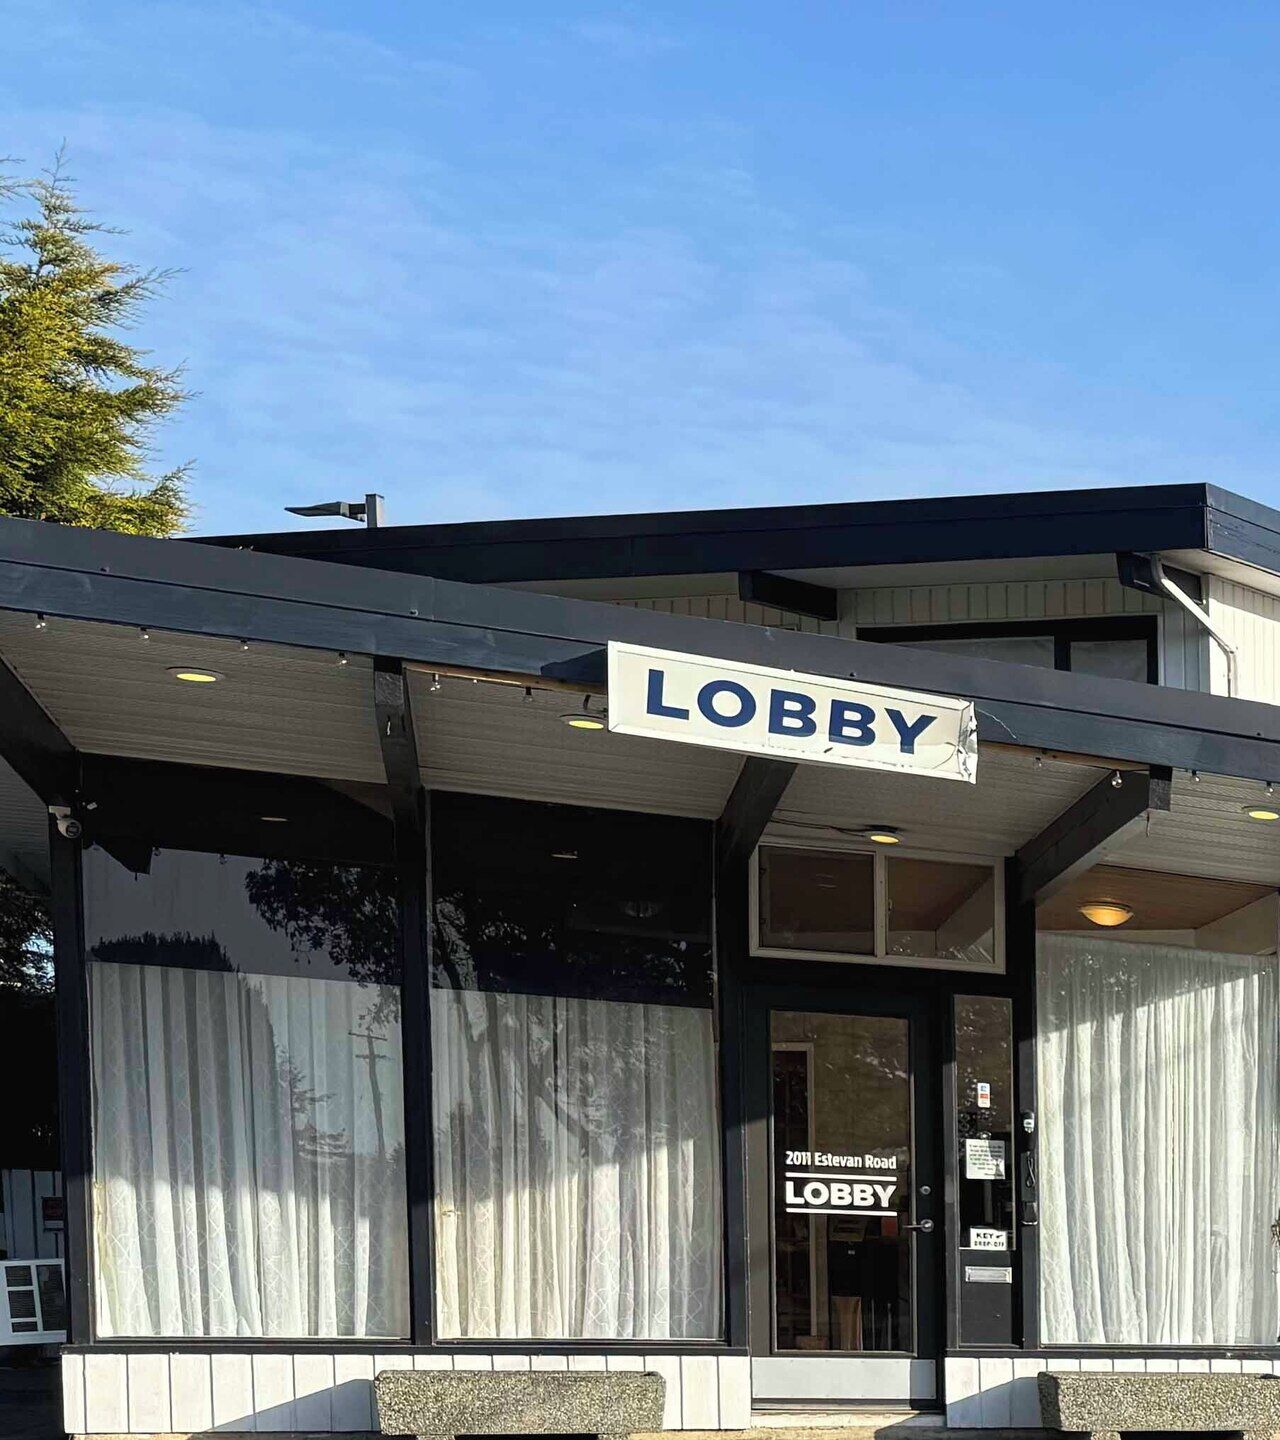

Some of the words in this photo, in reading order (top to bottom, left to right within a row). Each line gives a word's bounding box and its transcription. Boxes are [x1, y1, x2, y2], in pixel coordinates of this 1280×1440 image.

[647, 668, 938, 755] LOBBY
[785, 1151, 812, 1166] 2011
[814, 1152, 862, 1168] Estevan
[864, 1154, 897, 1170] Road
[785, 1181, 897, 1208] LOBBY
